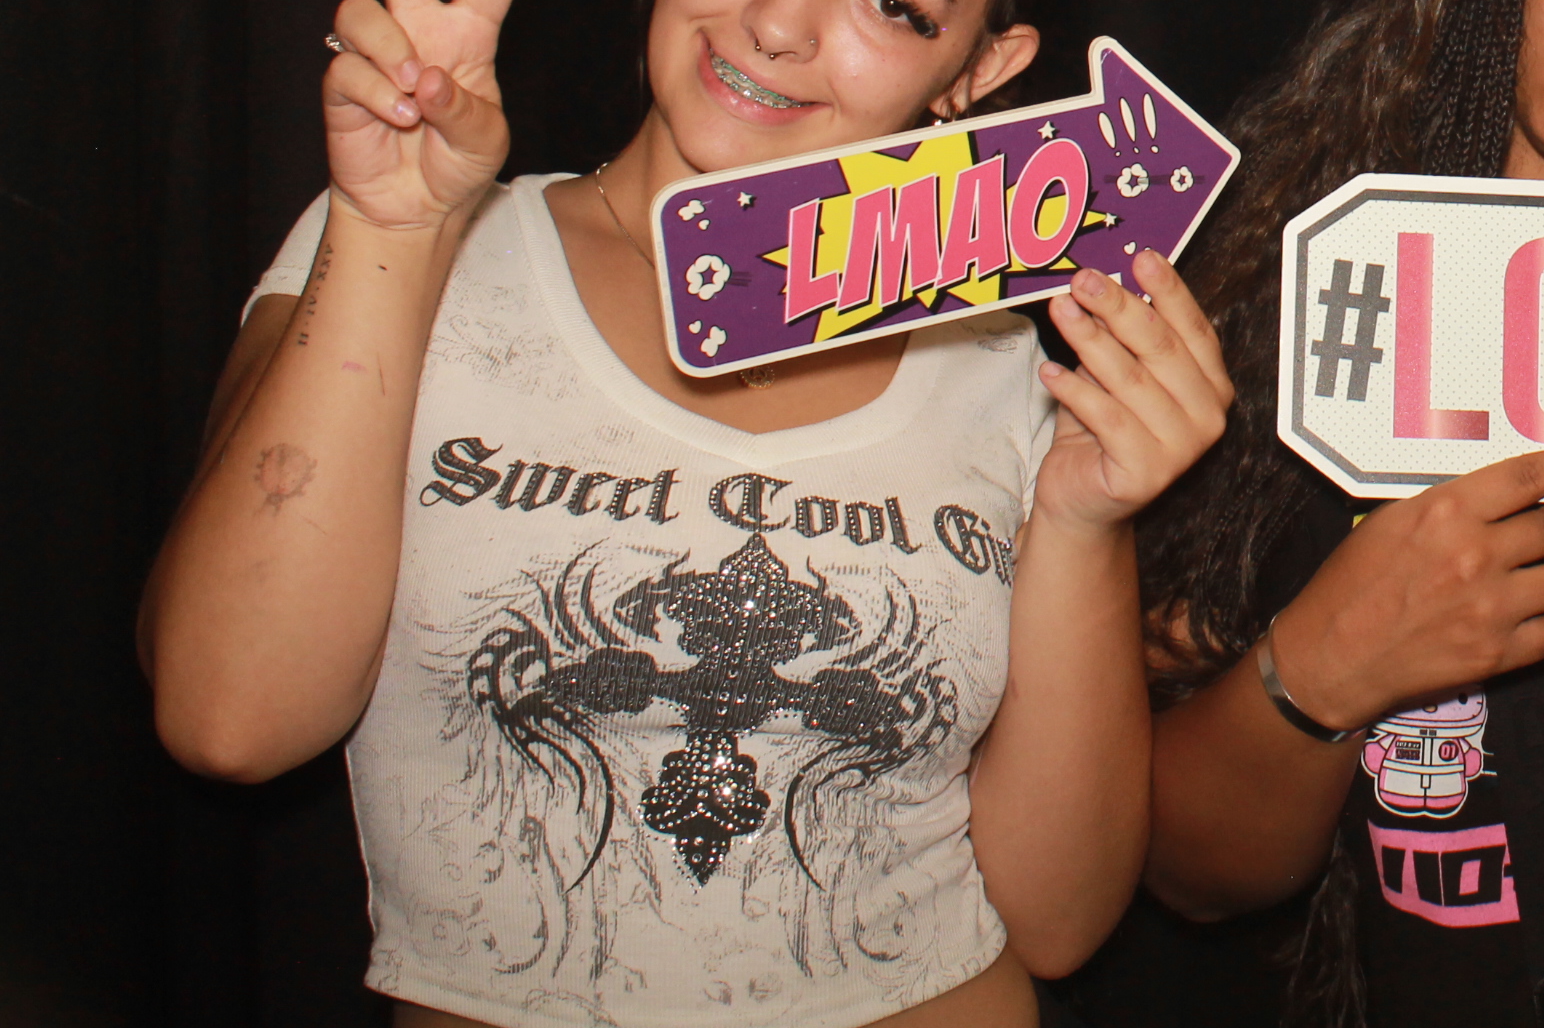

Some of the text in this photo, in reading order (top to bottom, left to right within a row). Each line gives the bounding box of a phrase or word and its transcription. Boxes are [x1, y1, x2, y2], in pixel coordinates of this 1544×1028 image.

[784, 137, 1090, 324] LMAO
[419, 436, 681, 525] Sweet
[709, 472, 923, 555] Cool
[1440, 743, 1457, 760] 01
